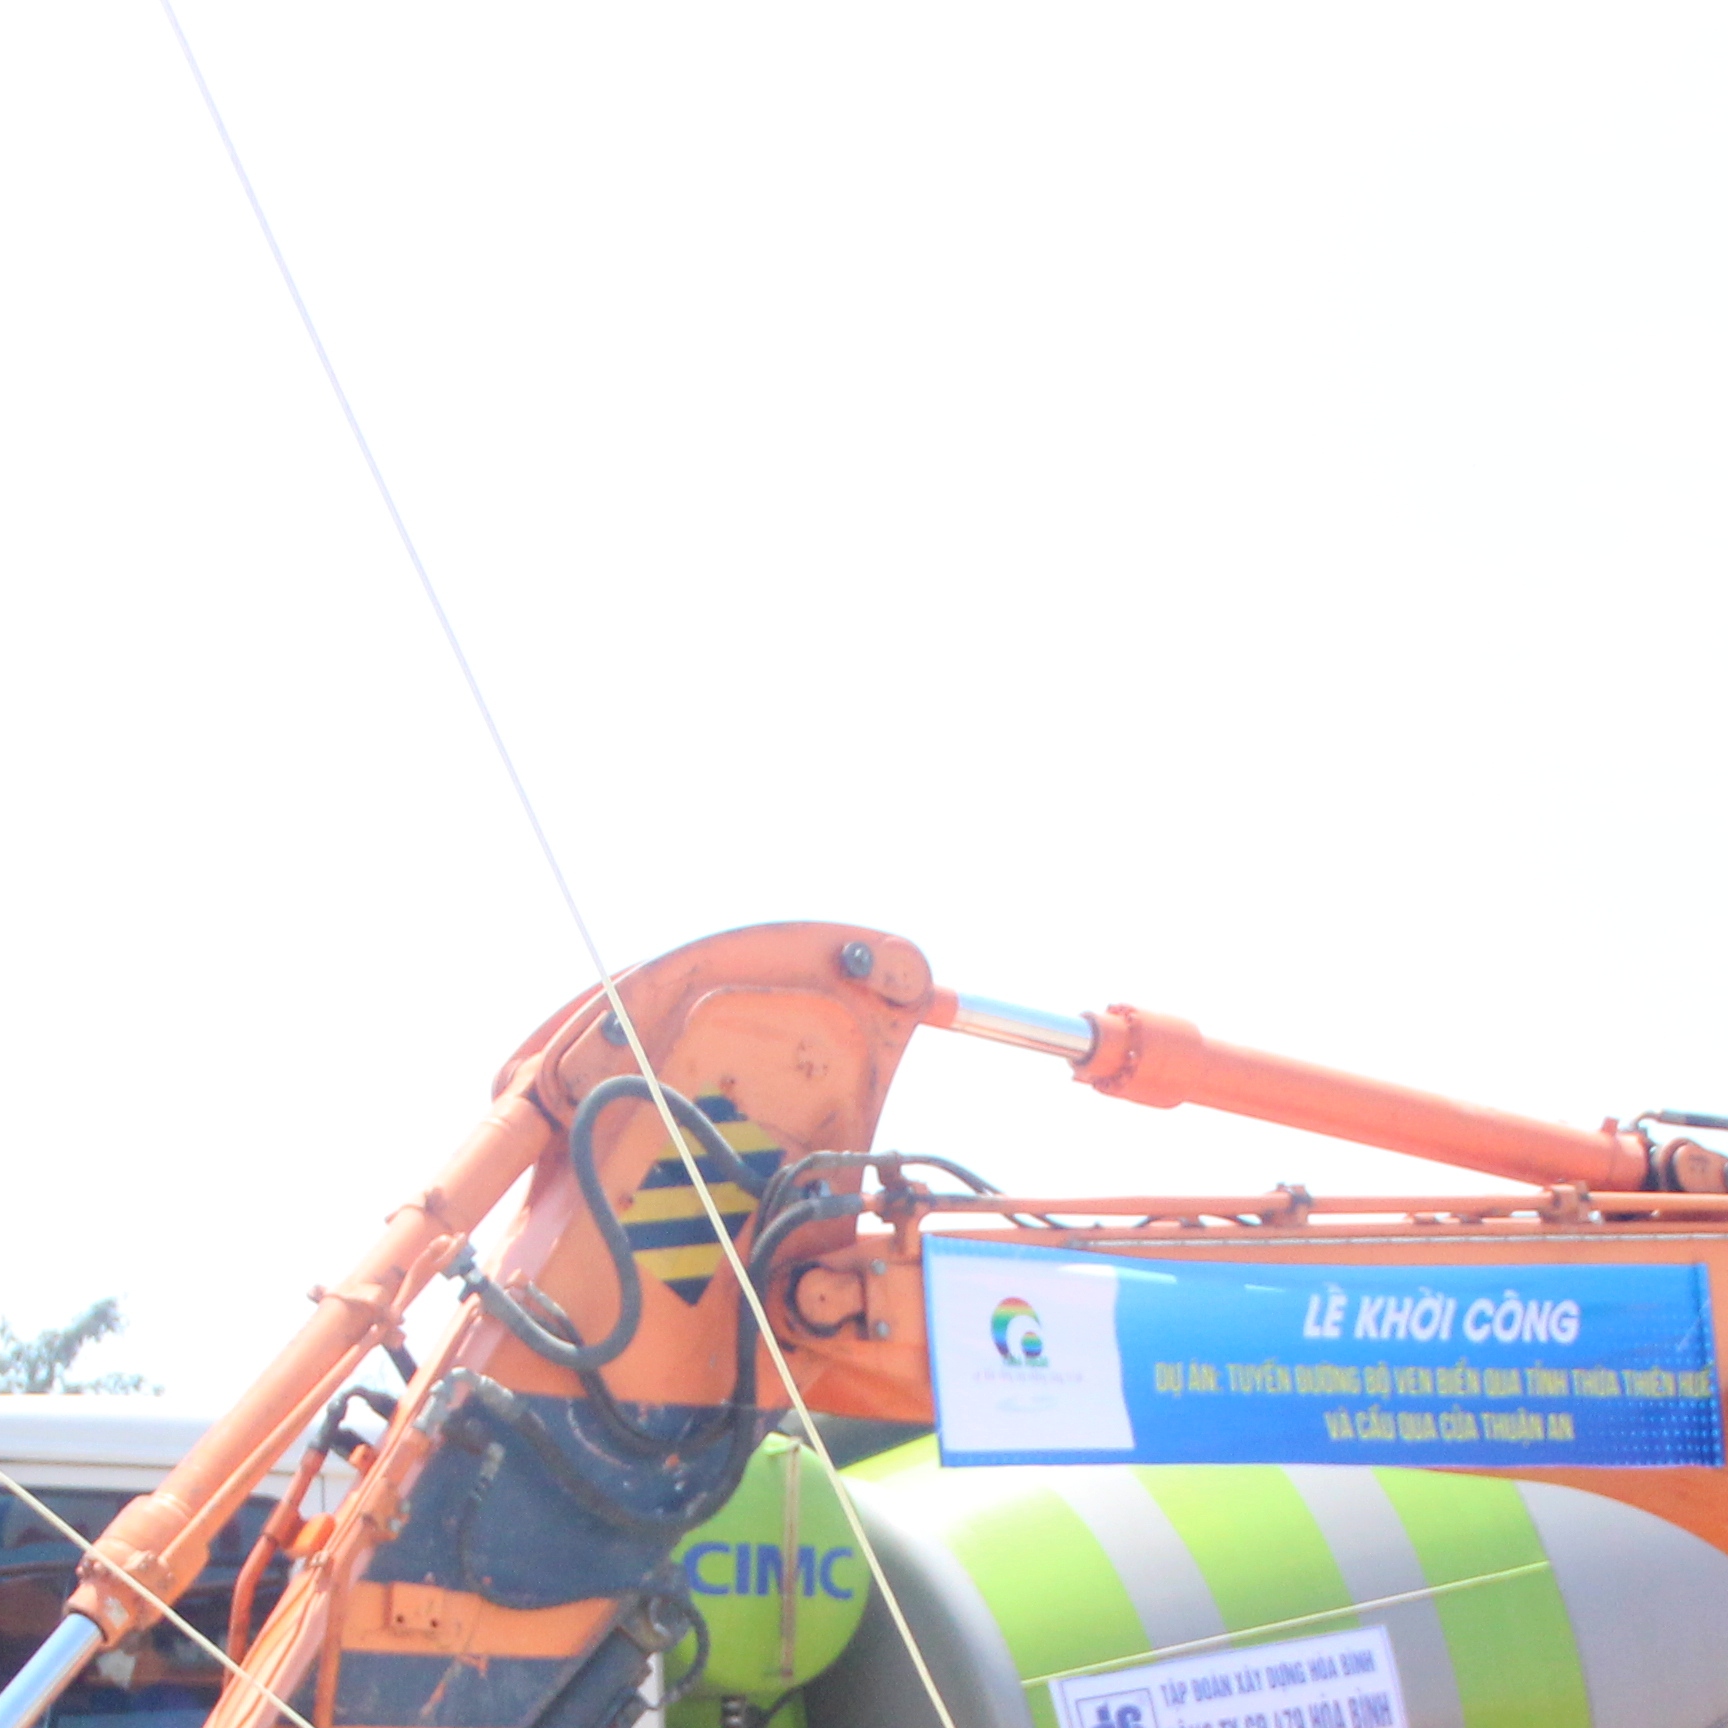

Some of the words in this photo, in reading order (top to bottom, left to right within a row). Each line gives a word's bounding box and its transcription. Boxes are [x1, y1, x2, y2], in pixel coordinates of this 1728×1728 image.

[1462, 1289, 1581, 1344] CÔNG
[1393, 1365, 1434, 1395] VEN
[682, 1540, 855, 1600] CIMC
